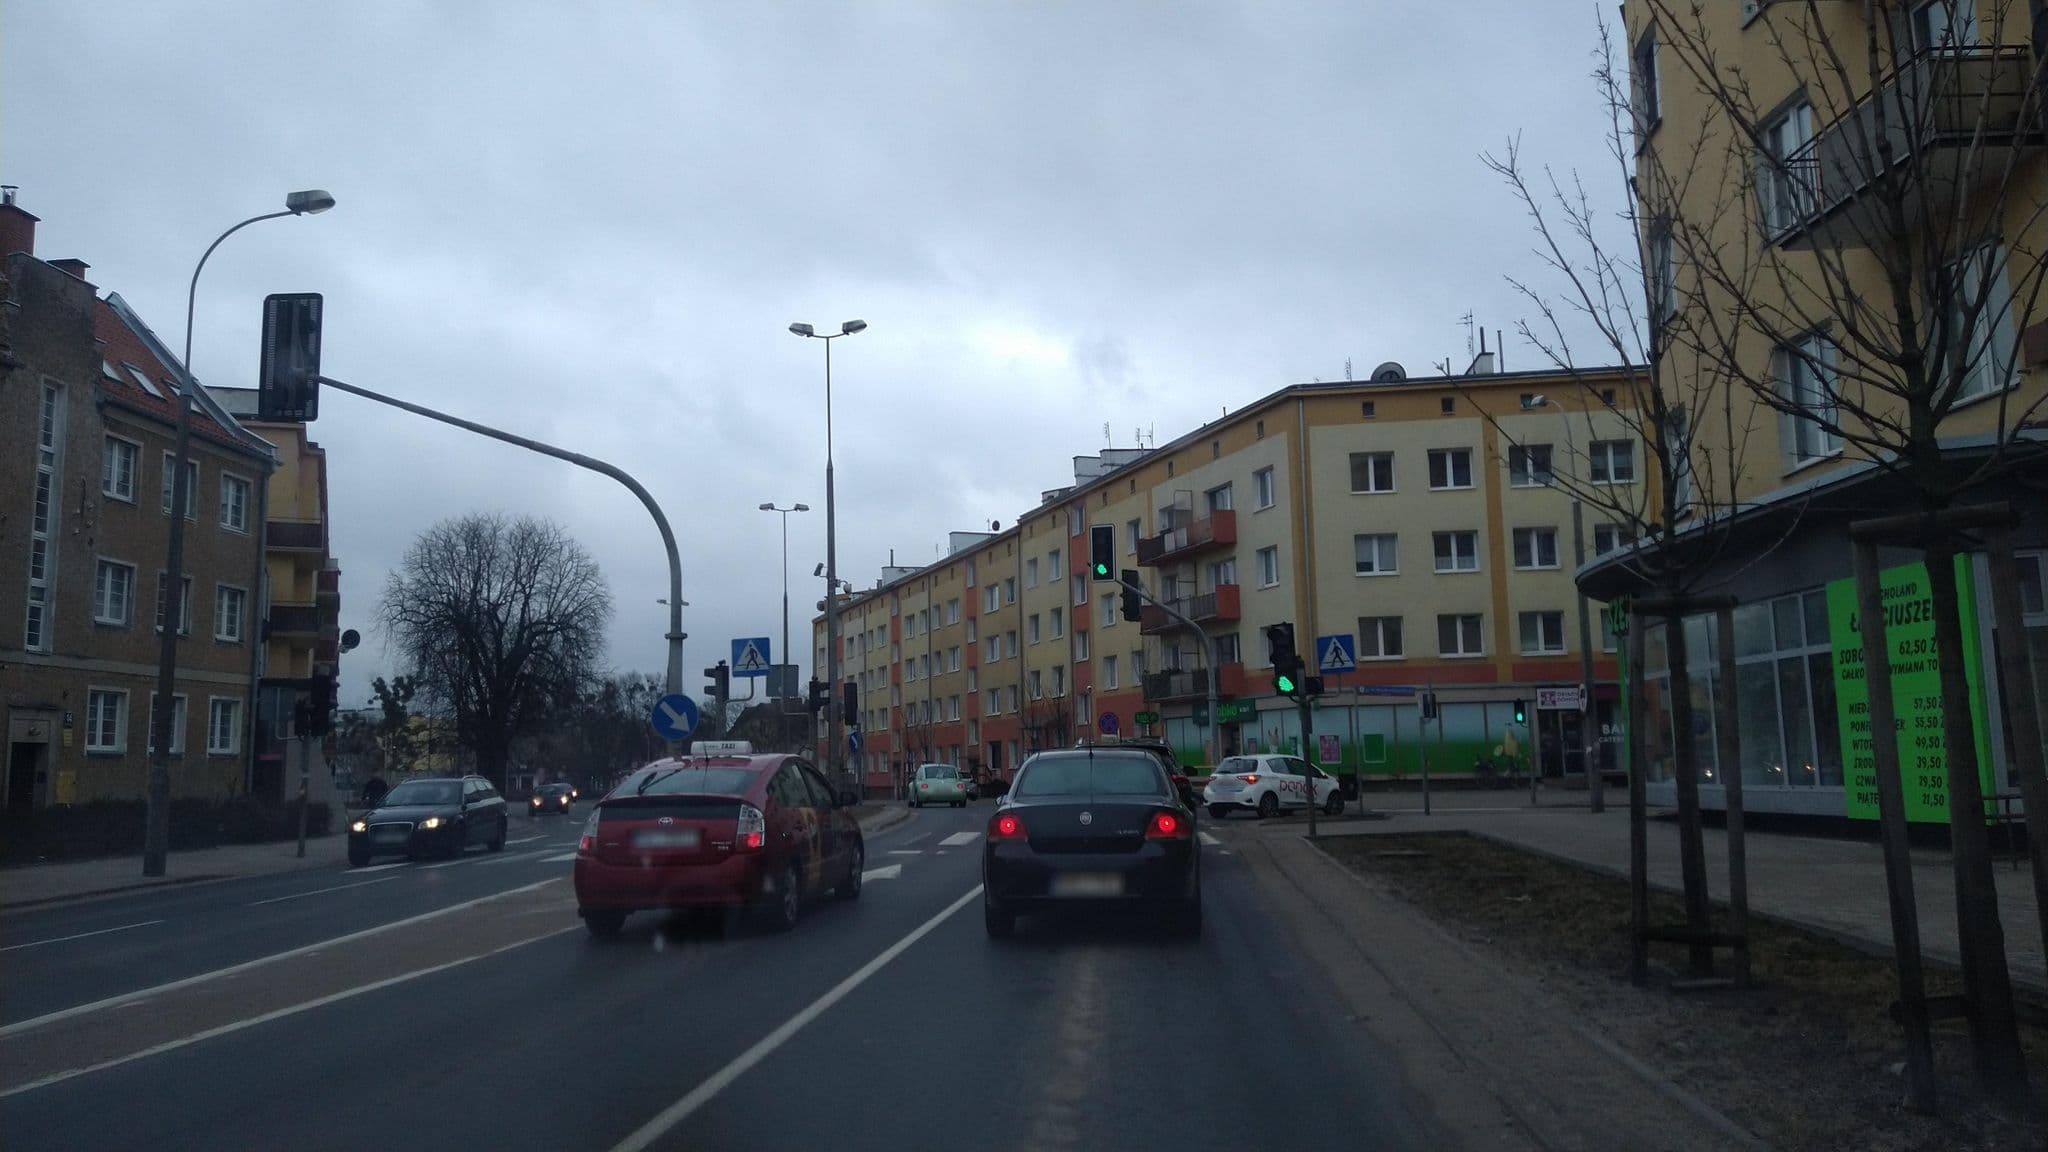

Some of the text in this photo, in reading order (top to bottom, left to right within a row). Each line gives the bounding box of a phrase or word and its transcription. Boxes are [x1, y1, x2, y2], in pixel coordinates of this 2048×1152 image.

[1840, 648, 1863, 665] SOBO
[1899, 639, 1927, 656] 62,50
[1842, 667, 1865, 680] CAŁKO
[1914, 697, 1937, 711] 57,50
[1915, 716, 1938, 731] 55,50
[1916, 756, 1941, 770] 39,50
